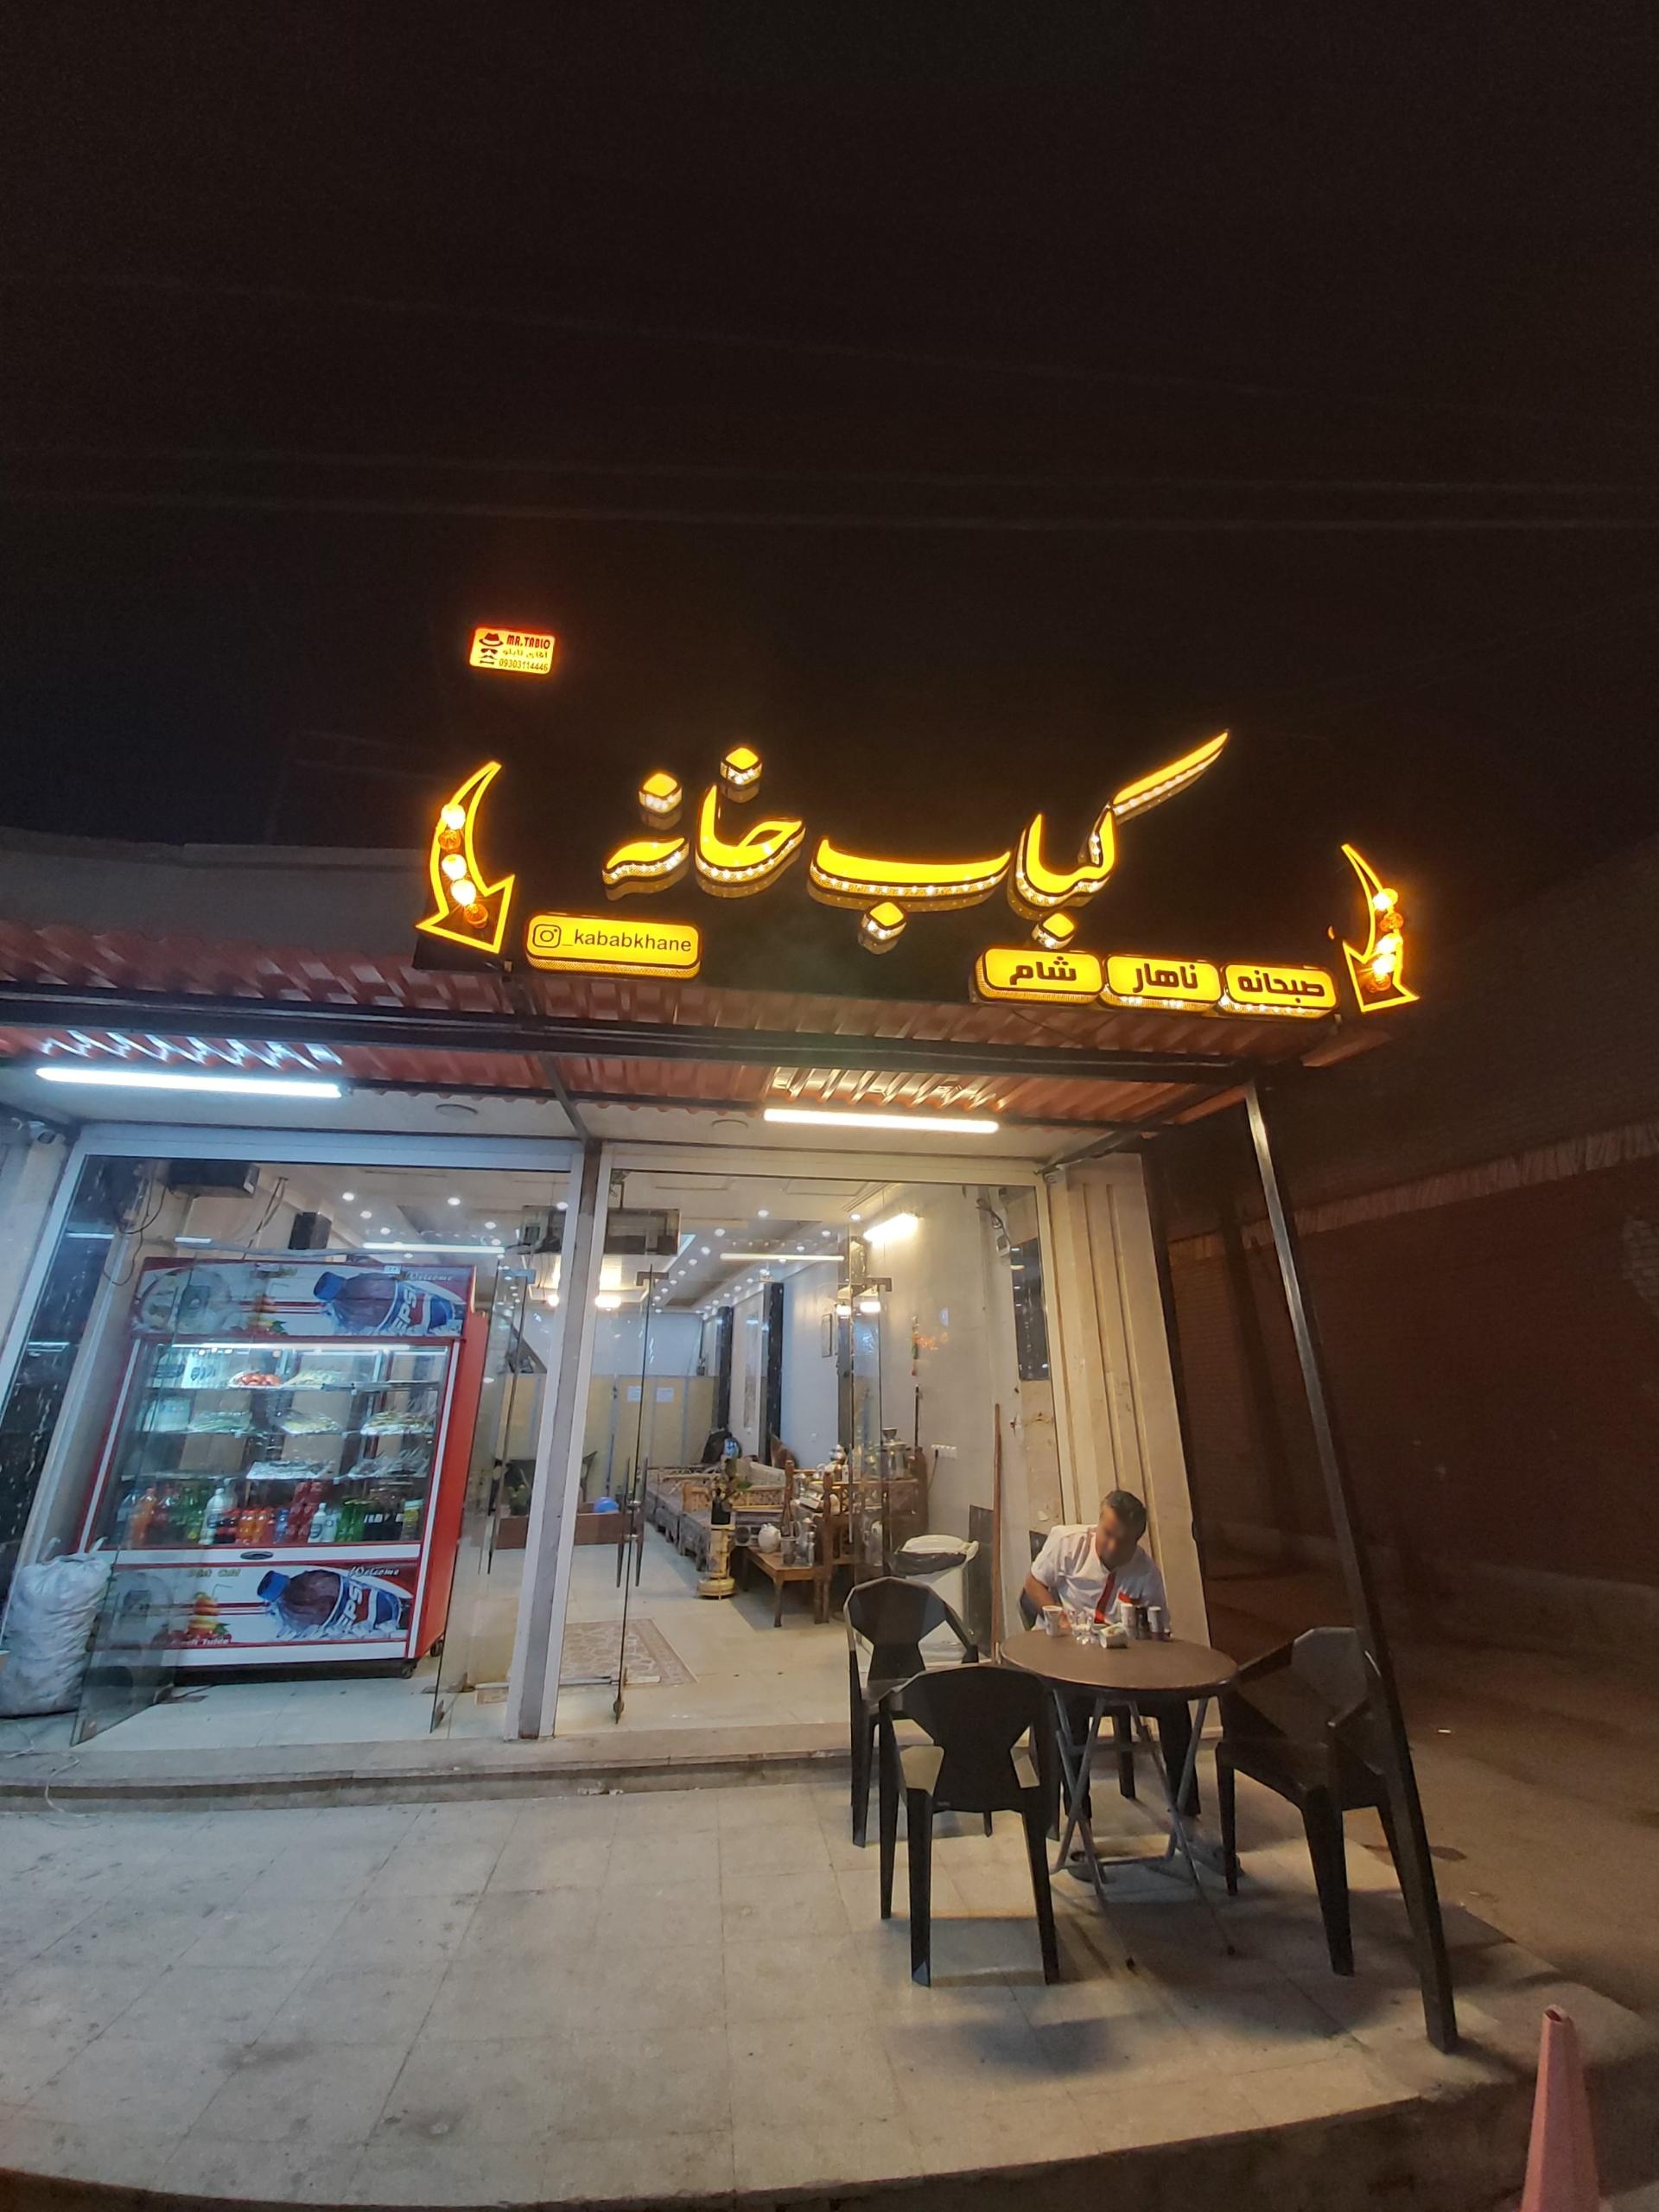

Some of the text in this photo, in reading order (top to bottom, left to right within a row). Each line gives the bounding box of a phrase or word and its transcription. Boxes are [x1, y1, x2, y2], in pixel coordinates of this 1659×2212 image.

[1008, 956, 1326, 1003] صبحانه ناهار شام
[348, 1566, 400, 1577] Welcome
